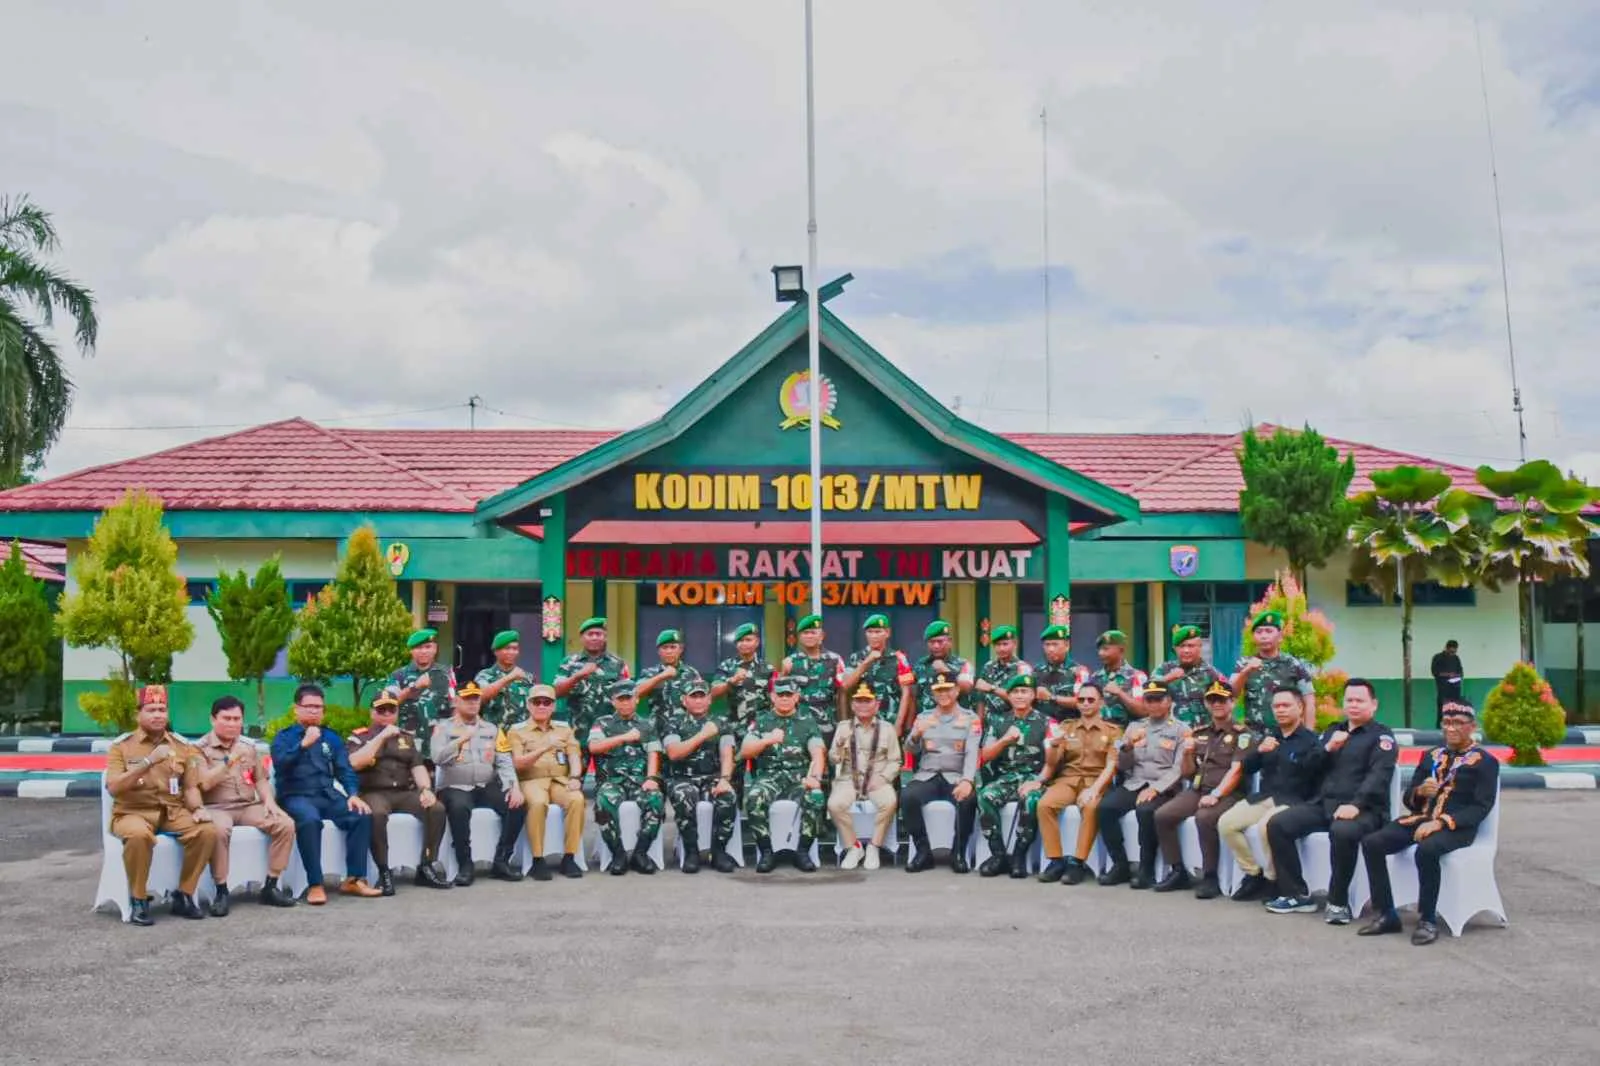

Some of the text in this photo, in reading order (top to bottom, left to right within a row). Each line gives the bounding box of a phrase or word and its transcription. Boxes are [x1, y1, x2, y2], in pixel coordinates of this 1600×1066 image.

[635, 473, 982, 510] KODIM 1013/MTW
[876, 550, 930, 577] TNI
[942, 549, 1032, 578] KUAT
[656, 582, 933, 605] KODIM 103/MTW
